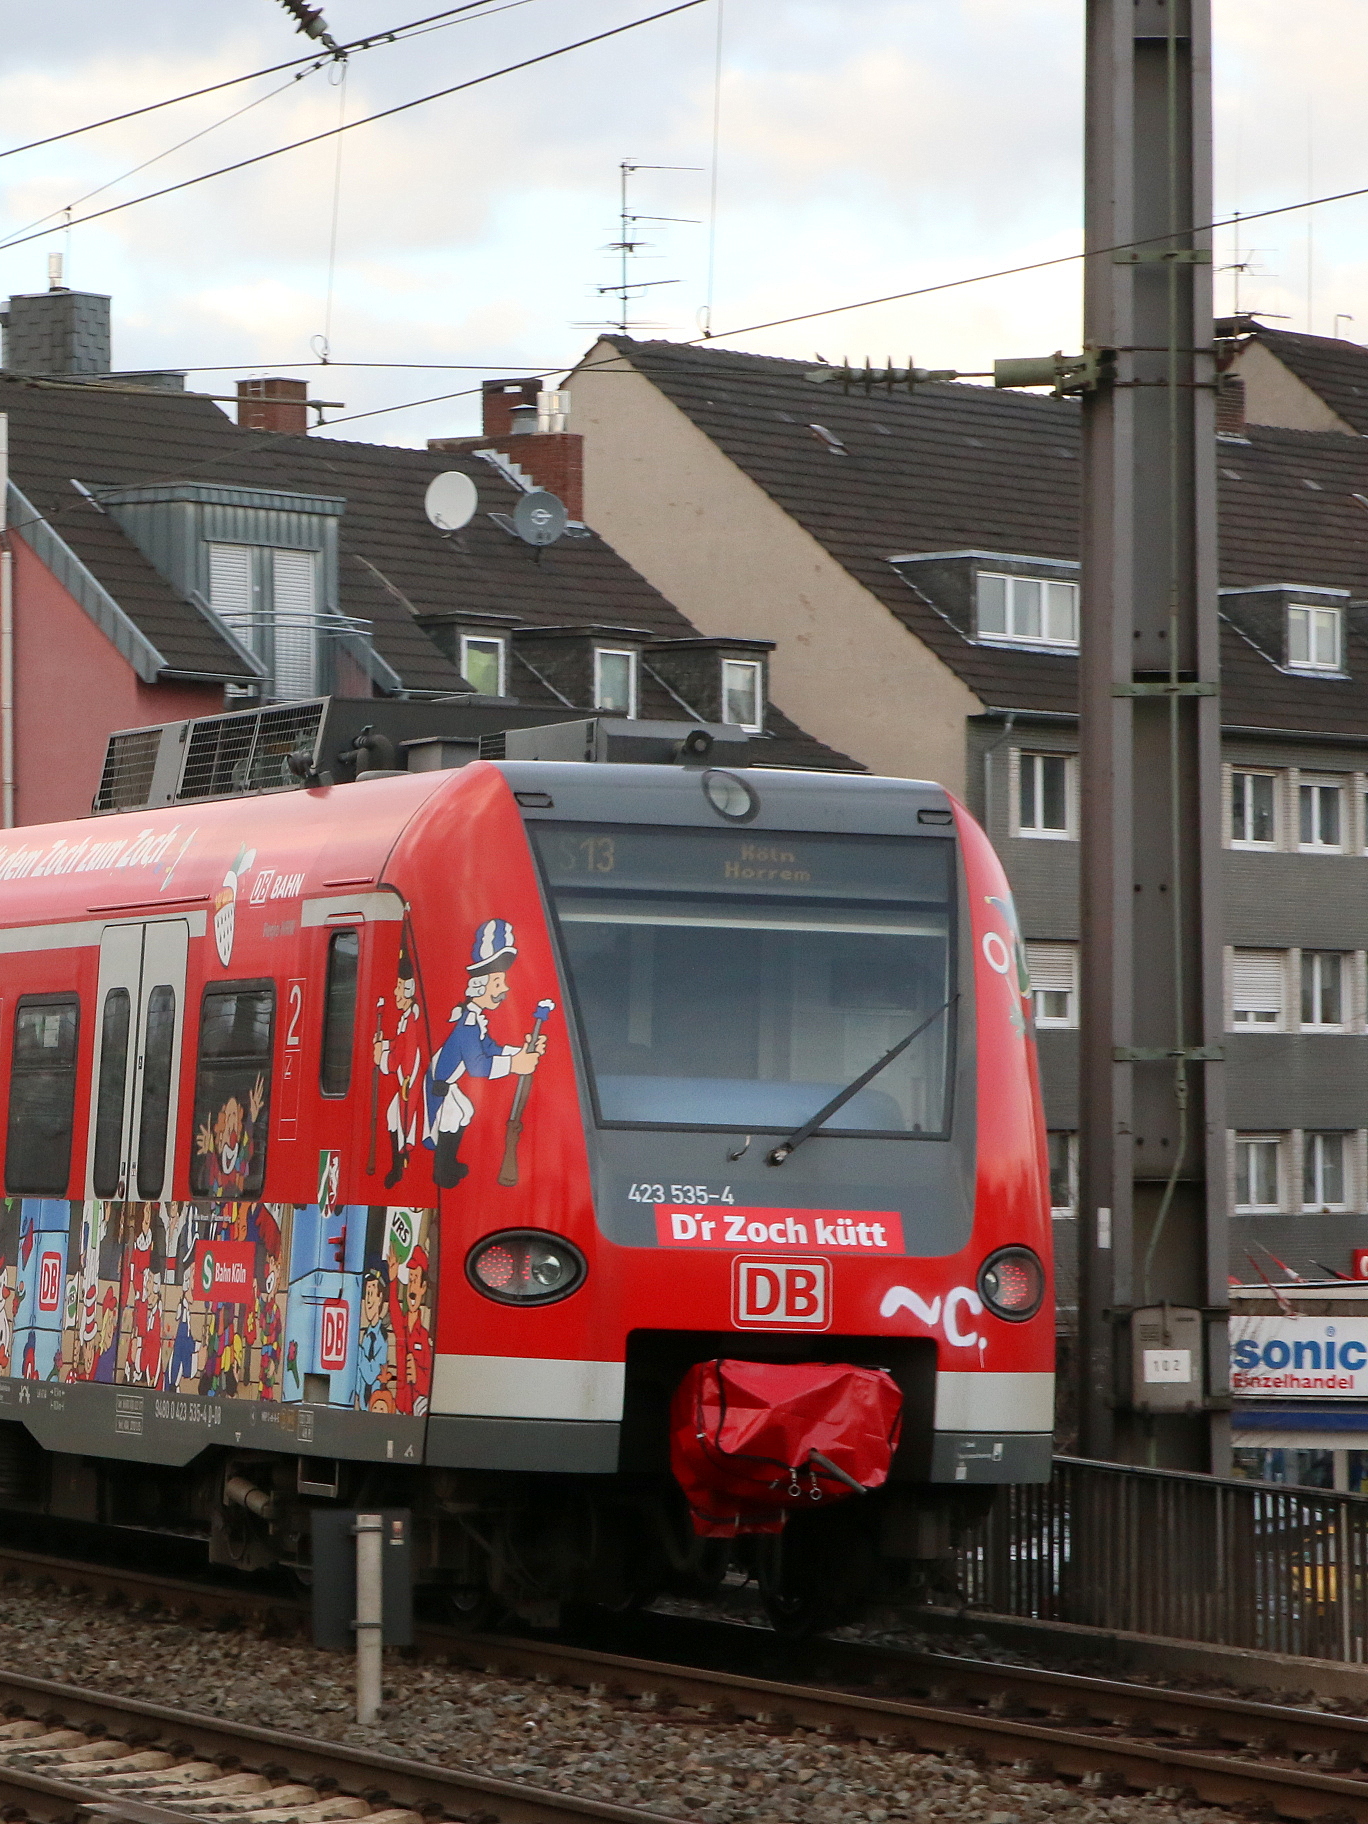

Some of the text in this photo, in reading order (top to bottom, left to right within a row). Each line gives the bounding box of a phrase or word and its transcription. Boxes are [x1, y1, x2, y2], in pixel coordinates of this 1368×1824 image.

[31, 835, 93, 878] Zoch
[75, 839, 128, 872] zum
[115, 823, 182, 868] Zoch
[270, 873, 306, 899] BAHN
[724, 861, 812, 882] Horrem
[287, 984, 302, 1046] 2
[628, 1184, 735, 1205] 423 535-4
[391, 1211, 411, 1243] VRS
[723, 1215, 808, 1245] Zoch
[815, 1218, 888, 1247] kütt
[41, 1261, 60, 1300] DB
[215, 1262, 231, 1281] Bahn
[232, 1263, 246, 1284] Köln
[745, 1267, 820, 1318] DB
[325, 1311, 345, 1357] DB
[1232, 1373, 1355, 1389] Einzelhandel
